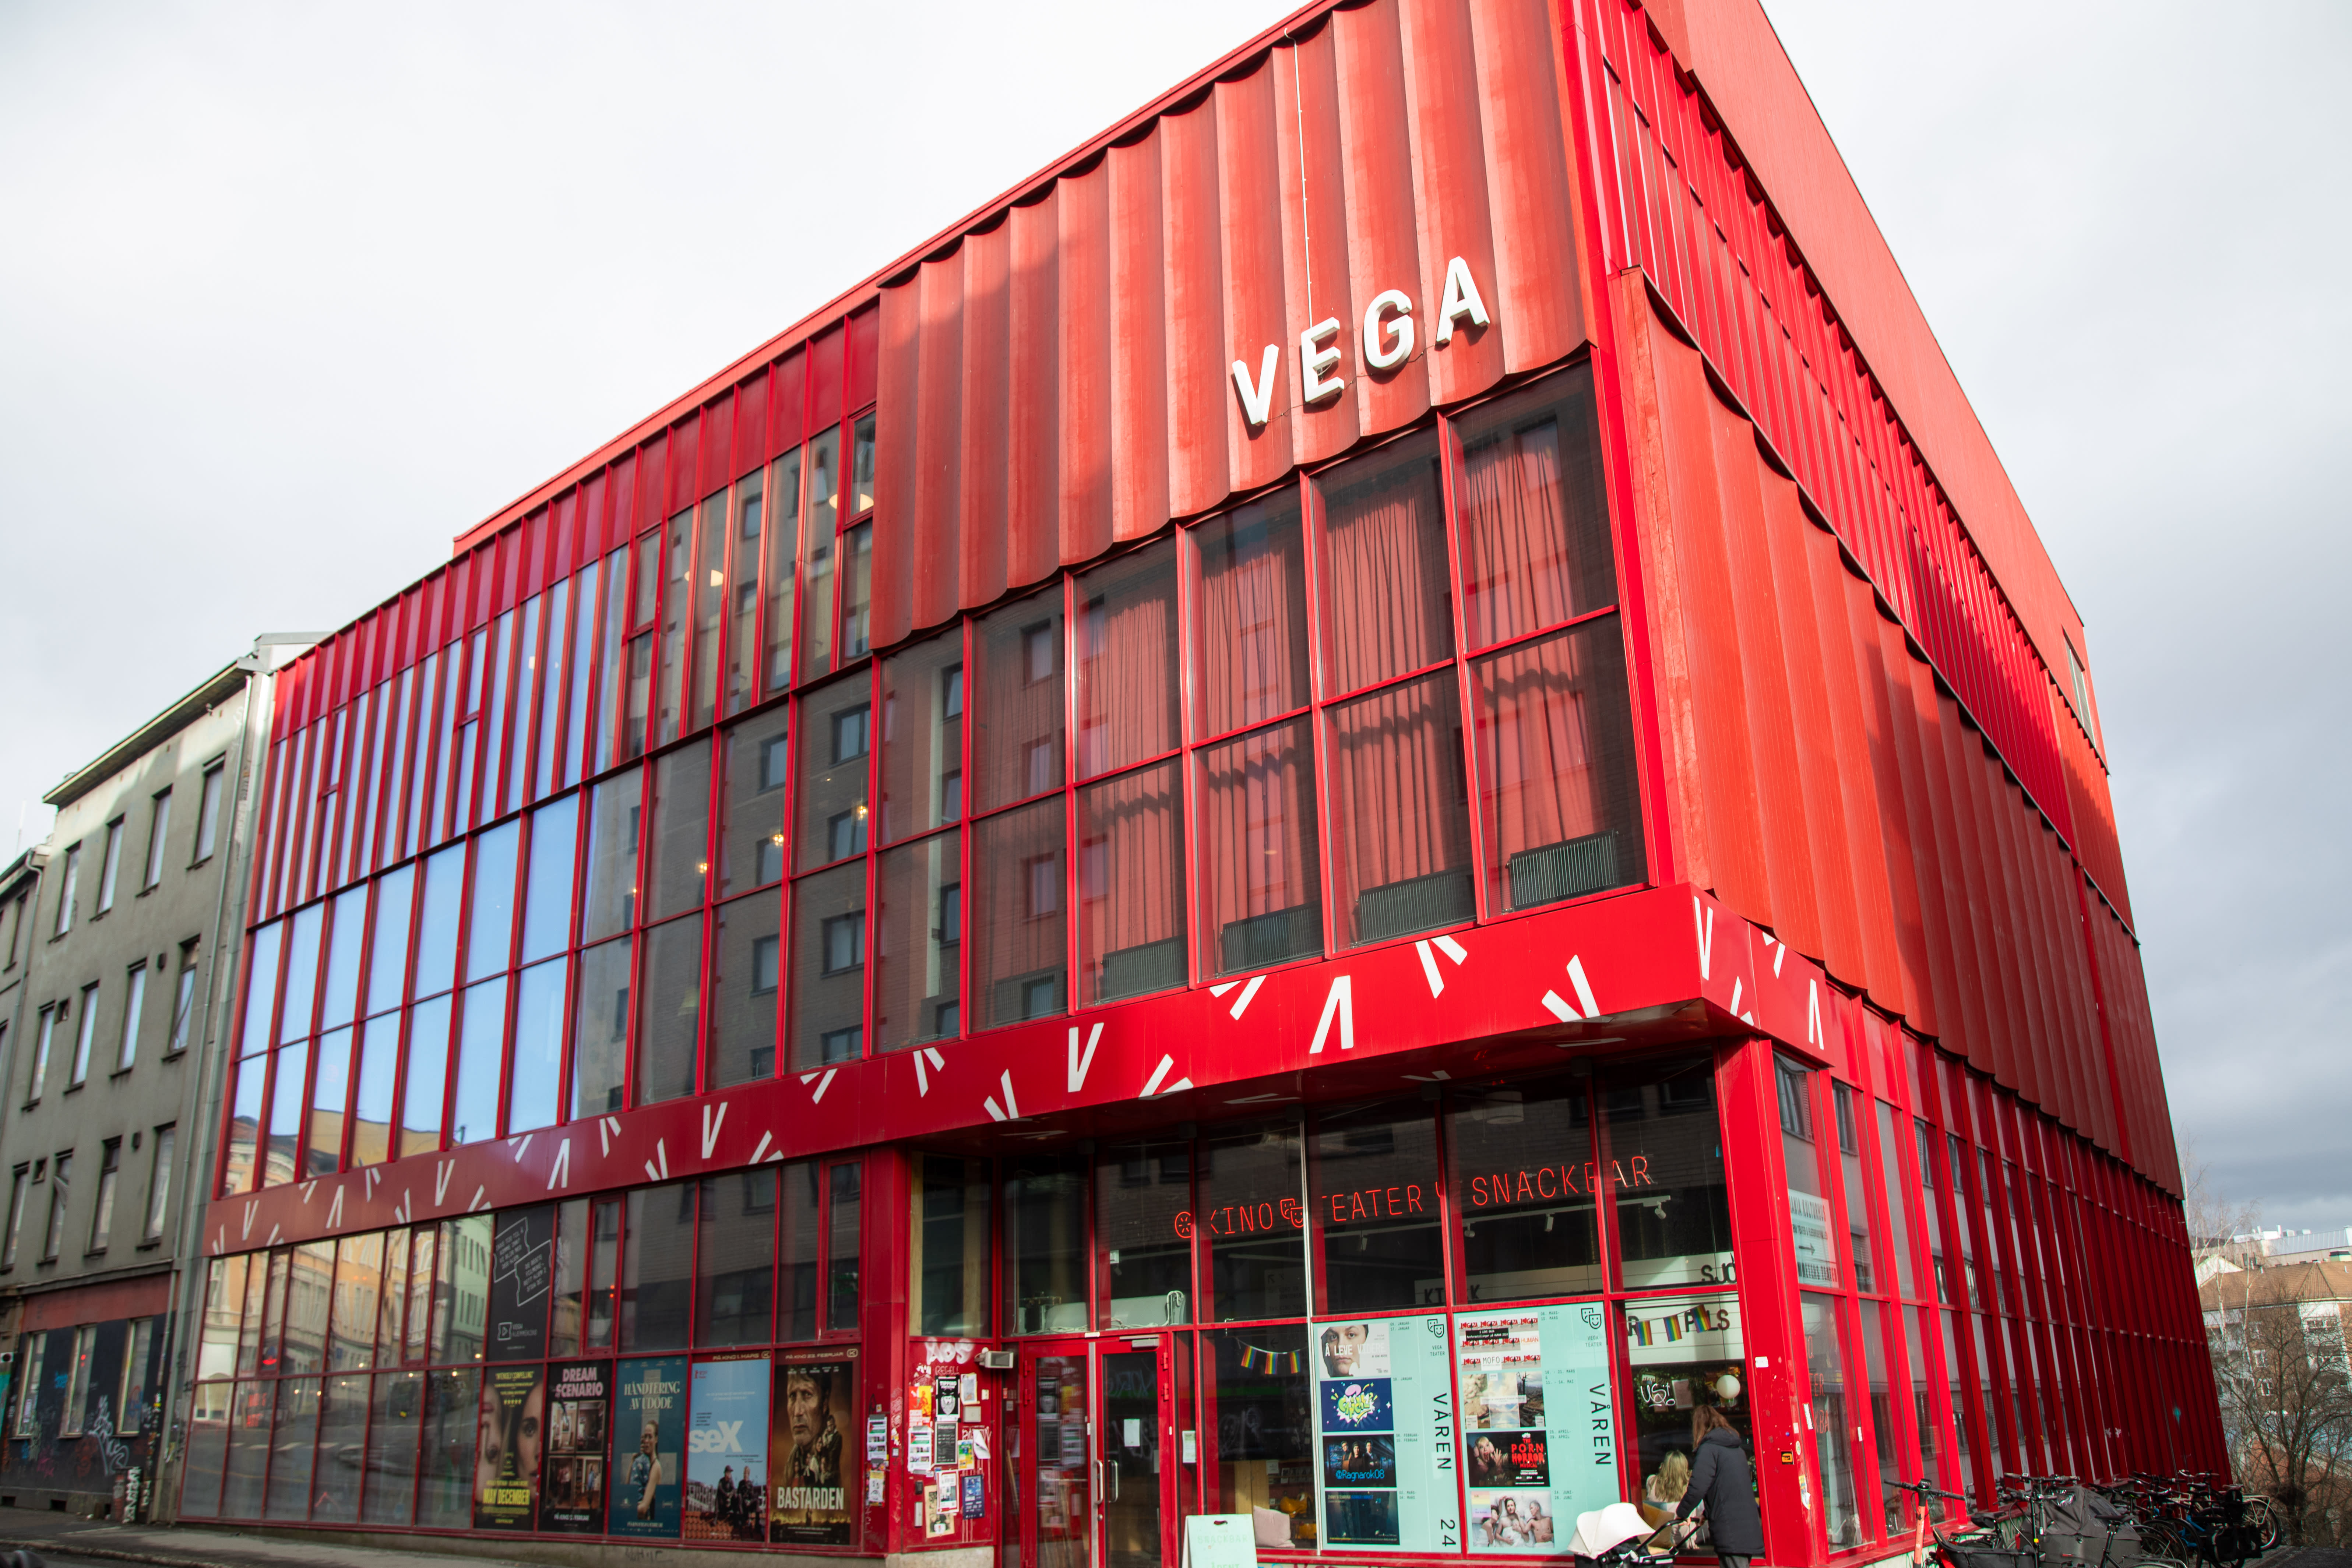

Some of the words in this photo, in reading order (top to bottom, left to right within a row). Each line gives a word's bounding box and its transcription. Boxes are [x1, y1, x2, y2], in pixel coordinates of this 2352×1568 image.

[1232, 256, 1490, 426] VEGA
[1322, 1185, 1423, 1222] EATER
[1325, 1343, 1331, 1357] Å
[1334, 1344, 1353, 1356] LEVE
[562, 1366, 597, 1382] DREAM
[555, 1382, 603, 1398] SCENARIO
[624, 1381, 680, 1396] HÅNDTERING
[629, 1398, 641, 1410] AV
[1433, 1393, 1452, 1469] VÅREN
[1589, 1383, 1611, 1464] VÅREN
[1511, 1443, 1544, 1453] PORN
[1511, 1452, 1545, 1465] HORROR
[1335, 1469, 1385, 1481] @Ragnarok08
[483, 1488, 496, 1504] MAY
[497, 1488, 530, 1505] DECEMBER
[777, 1487, 844, 1510] BASTARDEN
[1197, 1534, 1248, 1544] SNACKBAR
[1441, 1519, 1456, 1547] 24
